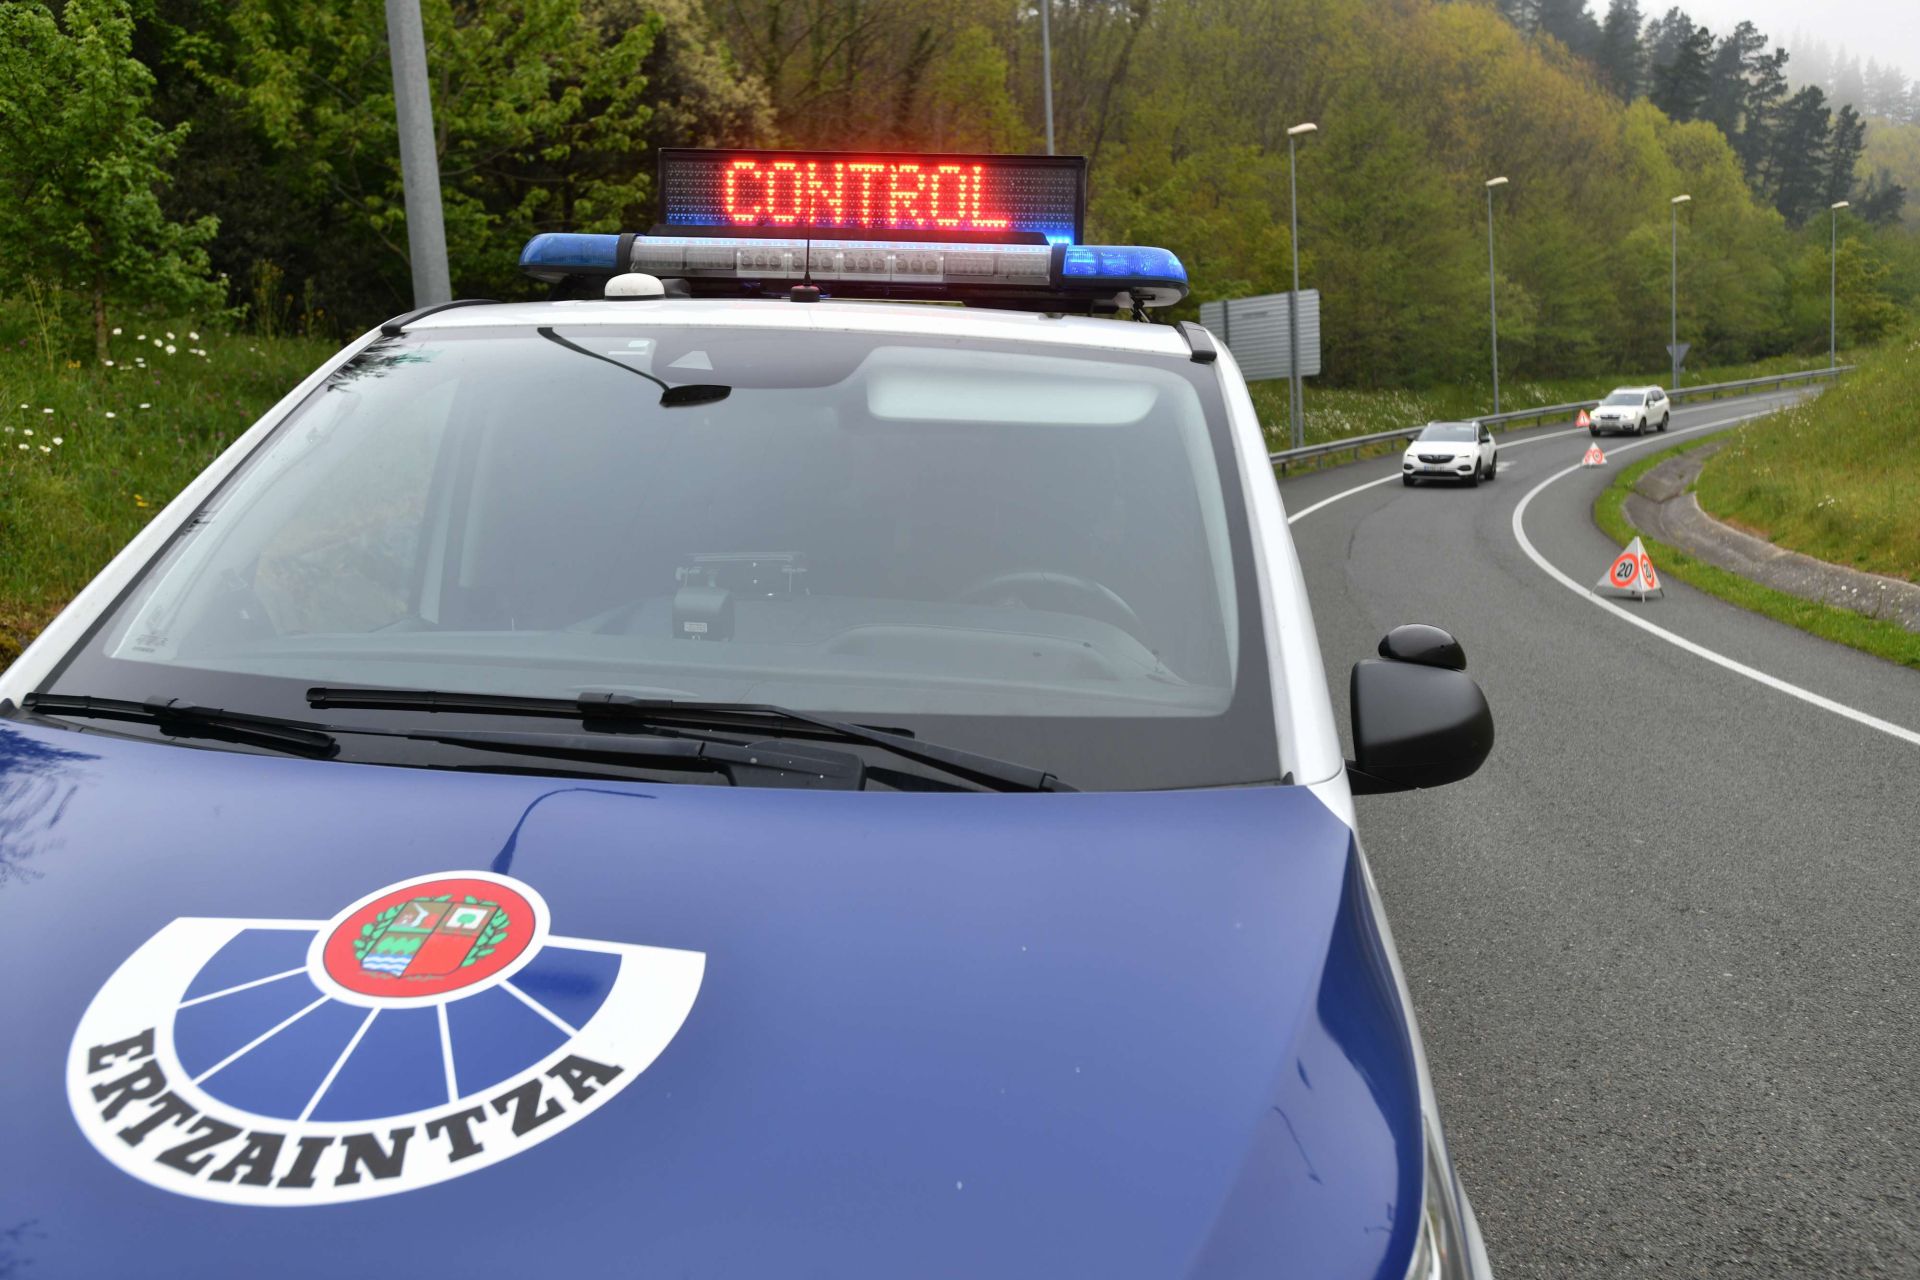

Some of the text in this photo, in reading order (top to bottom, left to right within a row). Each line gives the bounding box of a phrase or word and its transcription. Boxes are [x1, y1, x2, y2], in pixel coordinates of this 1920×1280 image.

[726, 161, 1009, 227] CONTROL
[1617, 562, 1633, 578] 20
[87, 1027, 625, 1188] ERTZAINTZA
